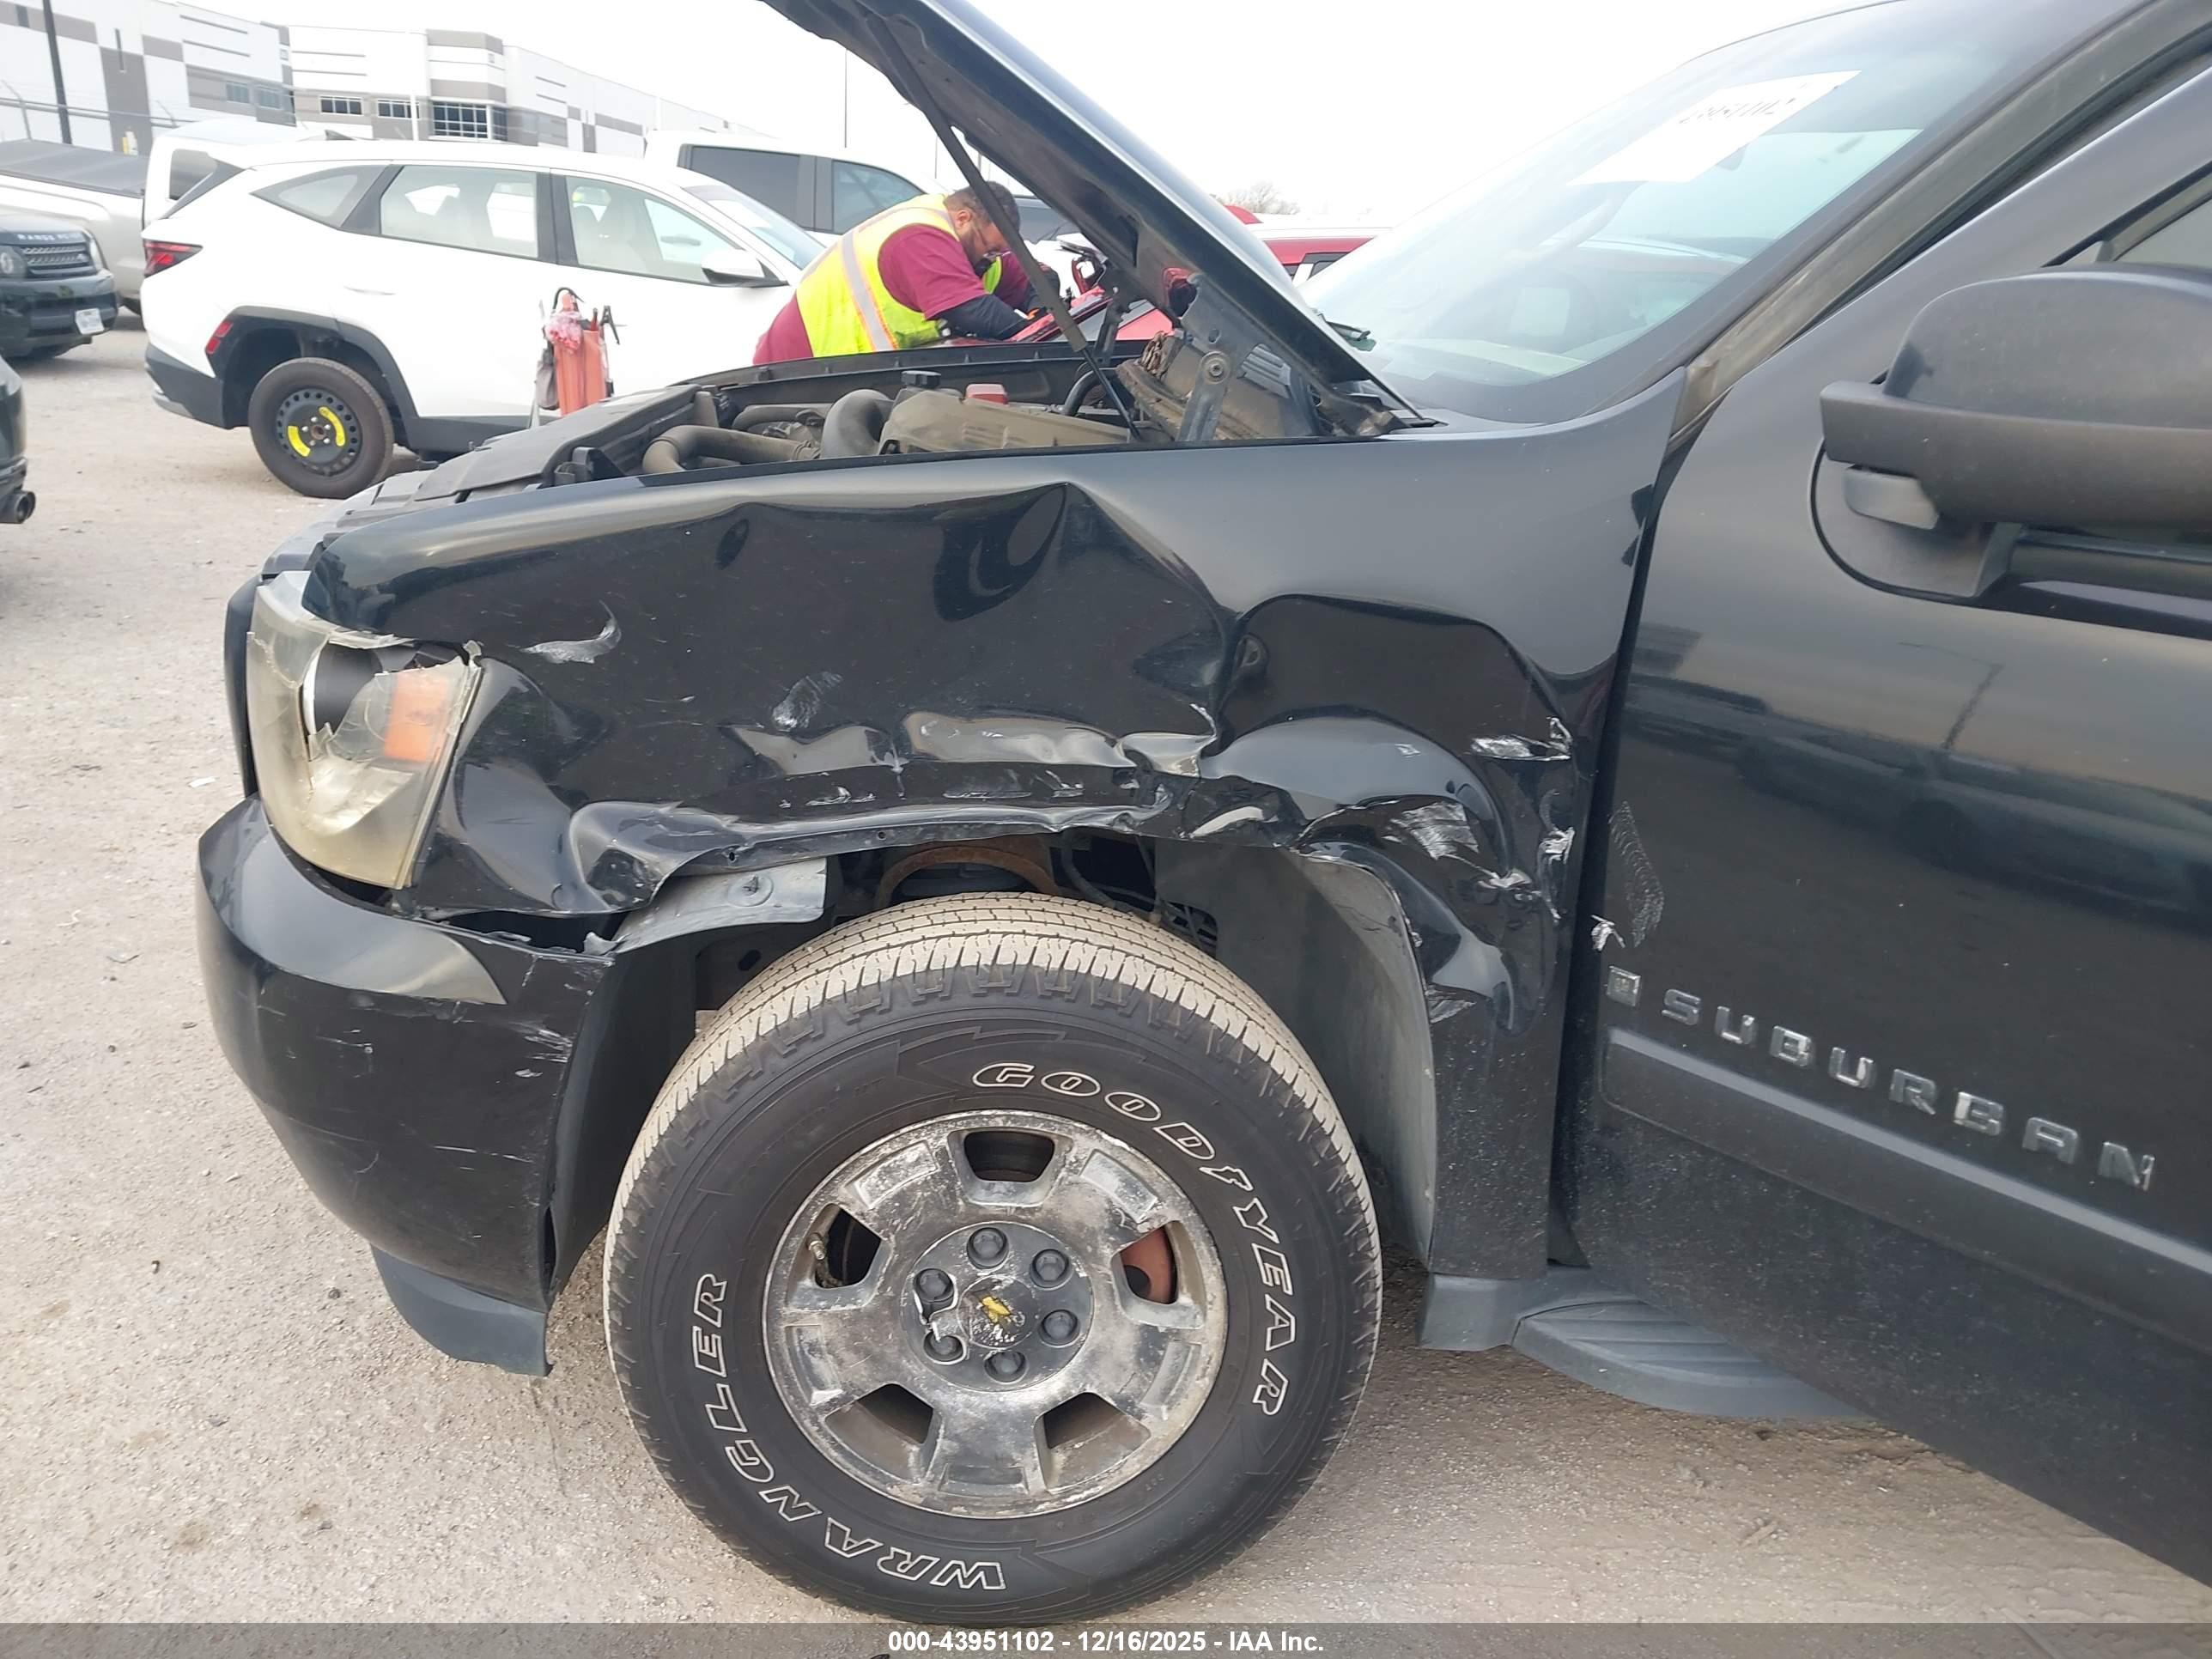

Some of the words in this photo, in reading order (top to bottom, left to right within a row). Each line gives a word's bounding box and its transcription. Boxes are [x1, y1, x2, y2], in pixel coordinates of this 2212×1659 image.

[971, 1062, 1297, 1417] GOODYEAR
[1661, 988, 2157, 1191] SUBURBAN
[691, 1273, 1008, 1591] WRANGLER
